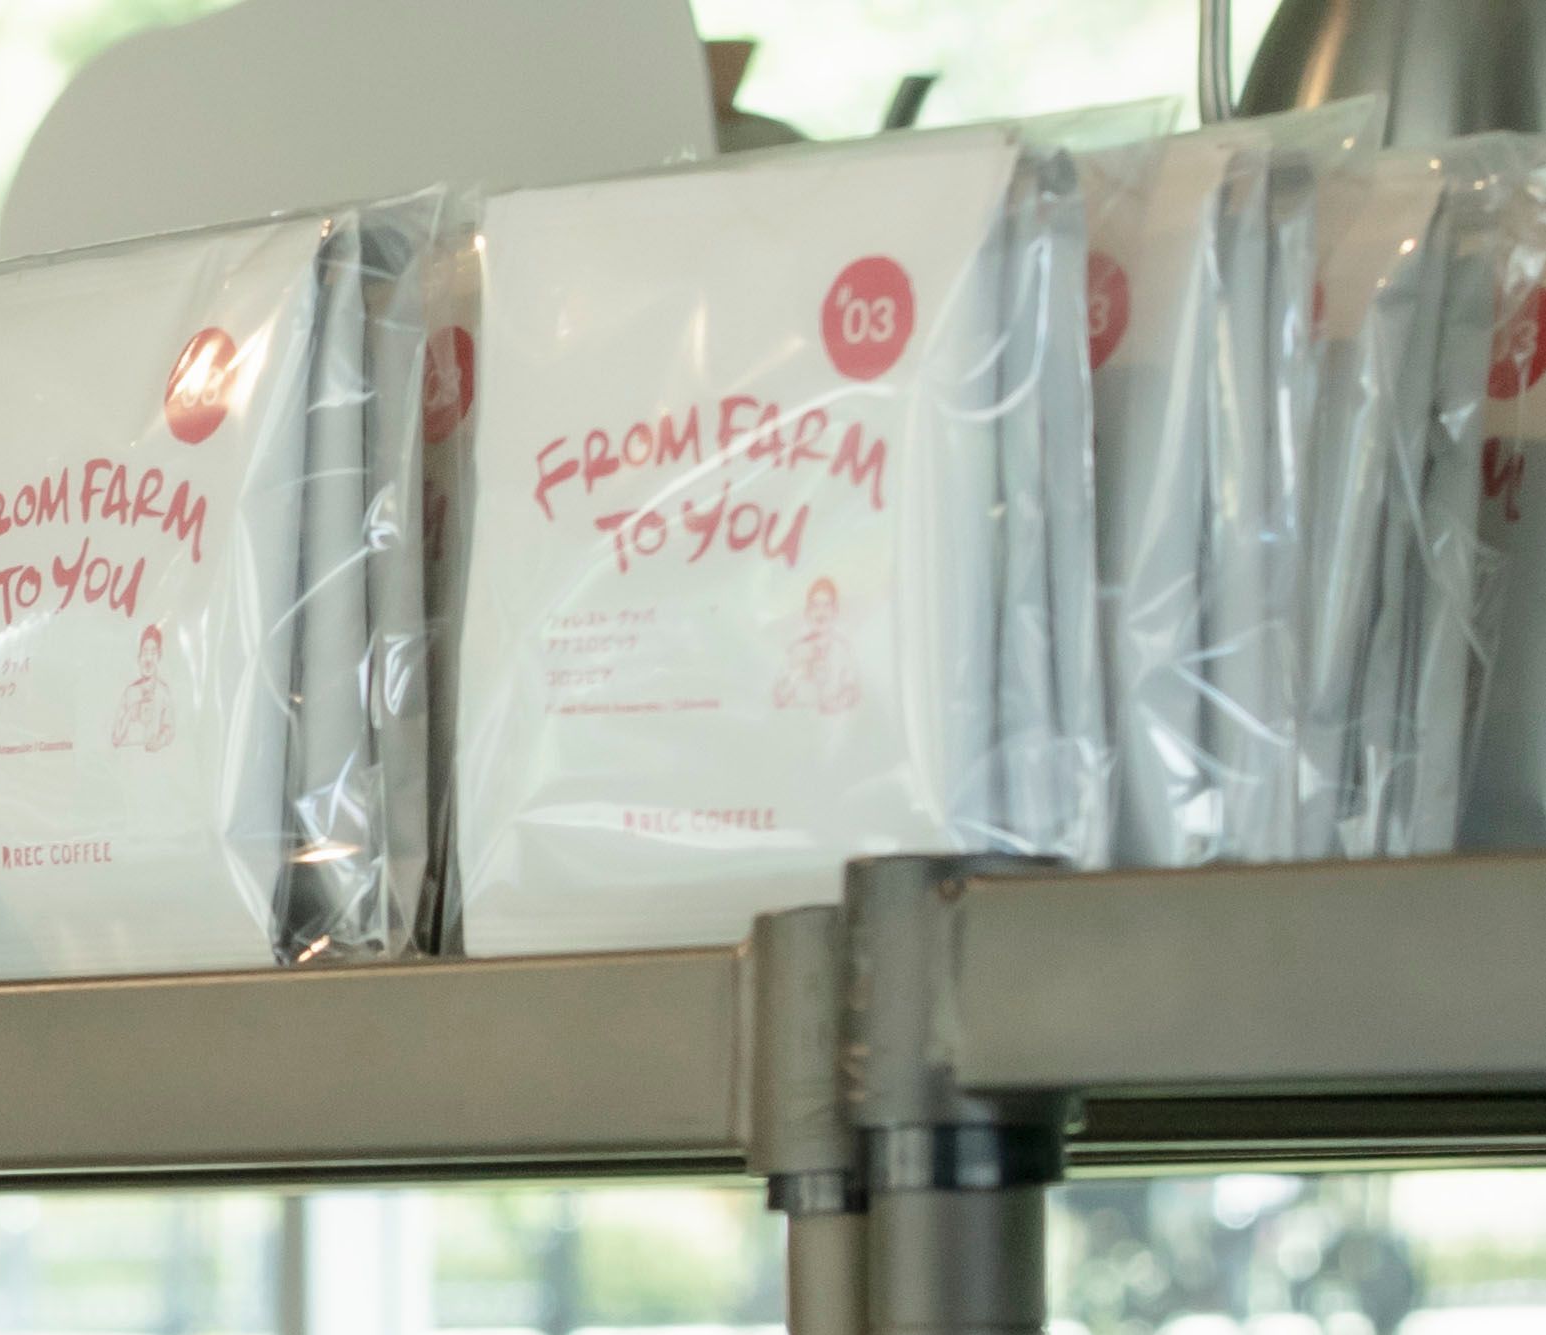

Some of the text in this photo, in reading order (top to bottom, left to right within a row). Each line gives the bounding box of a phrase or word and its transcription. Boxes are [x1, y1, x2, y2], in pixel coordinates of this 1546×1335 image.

[533, 394, 887, 522] FROM FARM
[80, 458, 207, 564] FARM
[594, 481, 810, 573] TO YOU
[51, 537, 146, 618] YOU
[14, 841, 113, 868] REC COFFEE
